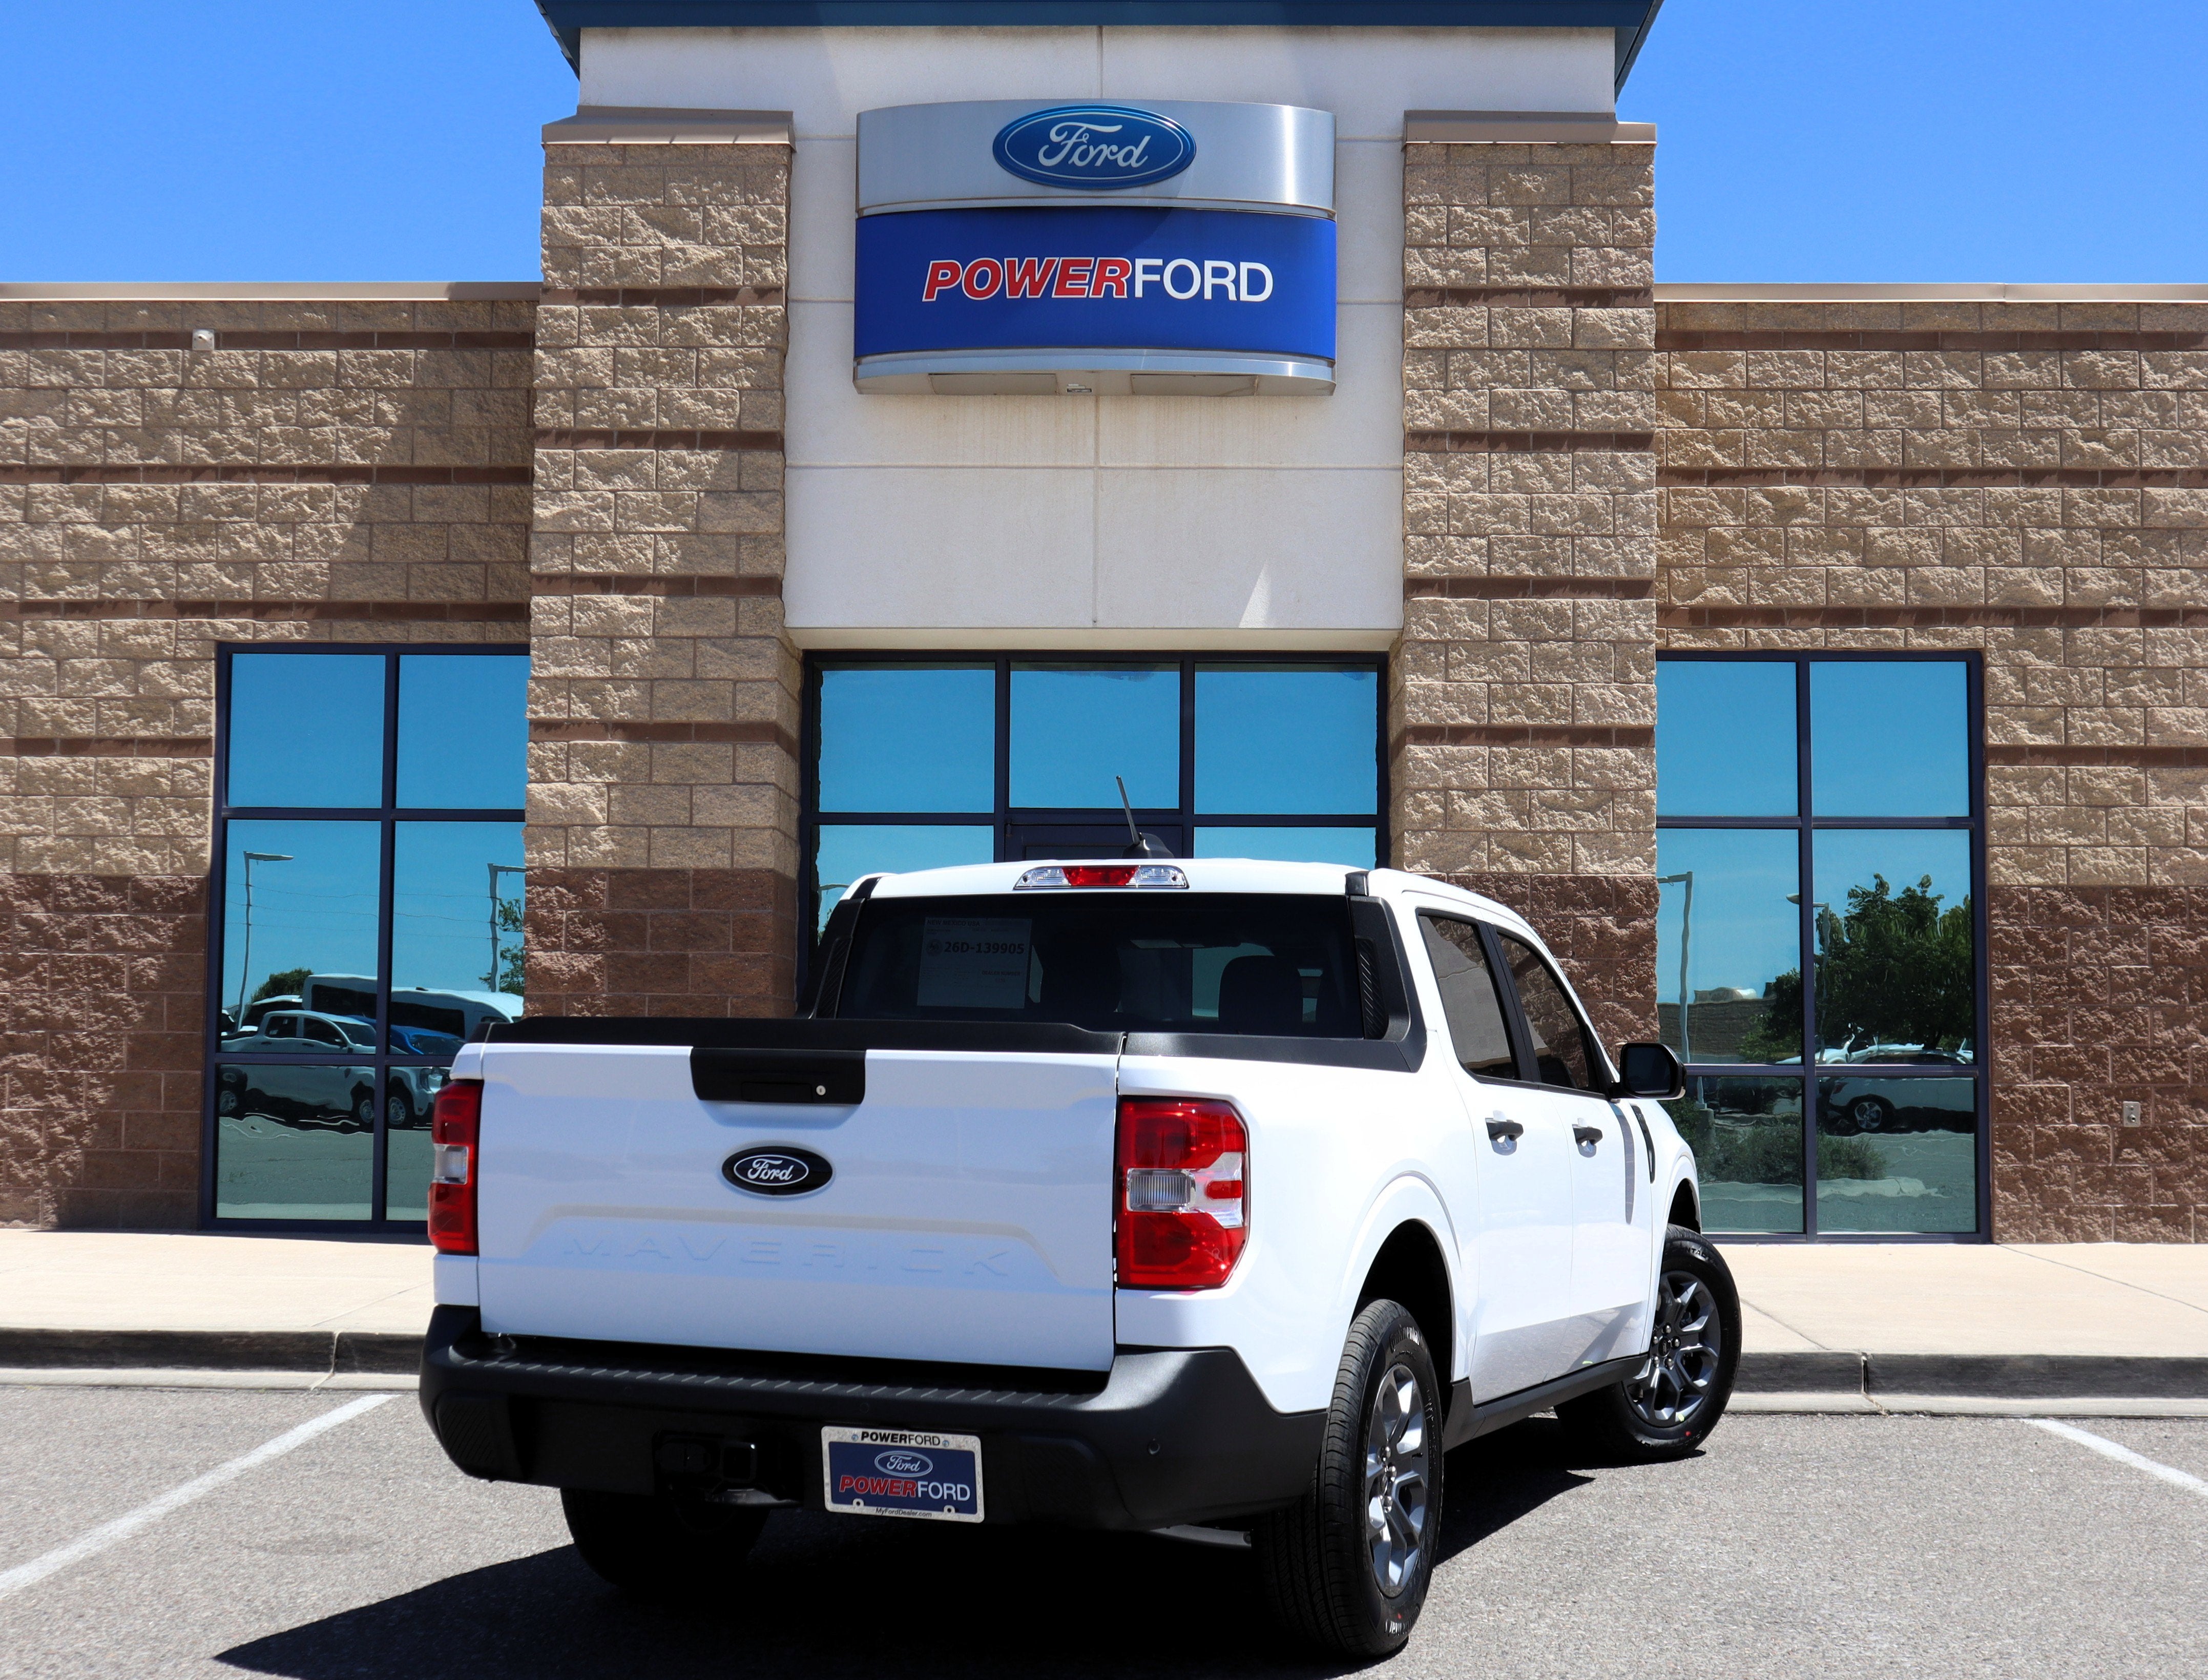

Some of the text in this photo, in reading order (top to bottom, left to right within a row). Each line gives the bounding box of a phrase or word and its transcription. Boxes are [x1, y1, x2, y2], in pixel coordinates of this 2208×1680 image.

[1038, 121, 1151, 168] Ford
[922, 257, 1274, 302] POWERFORD
[944, 941, 1025, 955] 26D-139905
[747, 1156, 794, 1183] Ford
[564, 1230, 1010, 1276] MAVERICK
[860, 1431, 941, 1446] POWERFORD
[886, 1455, 921, 1472] Ford
[839, 1475, 971, 1502] POWERFORD
[875, 1507, 932, 1518] MyFordDealer.com
